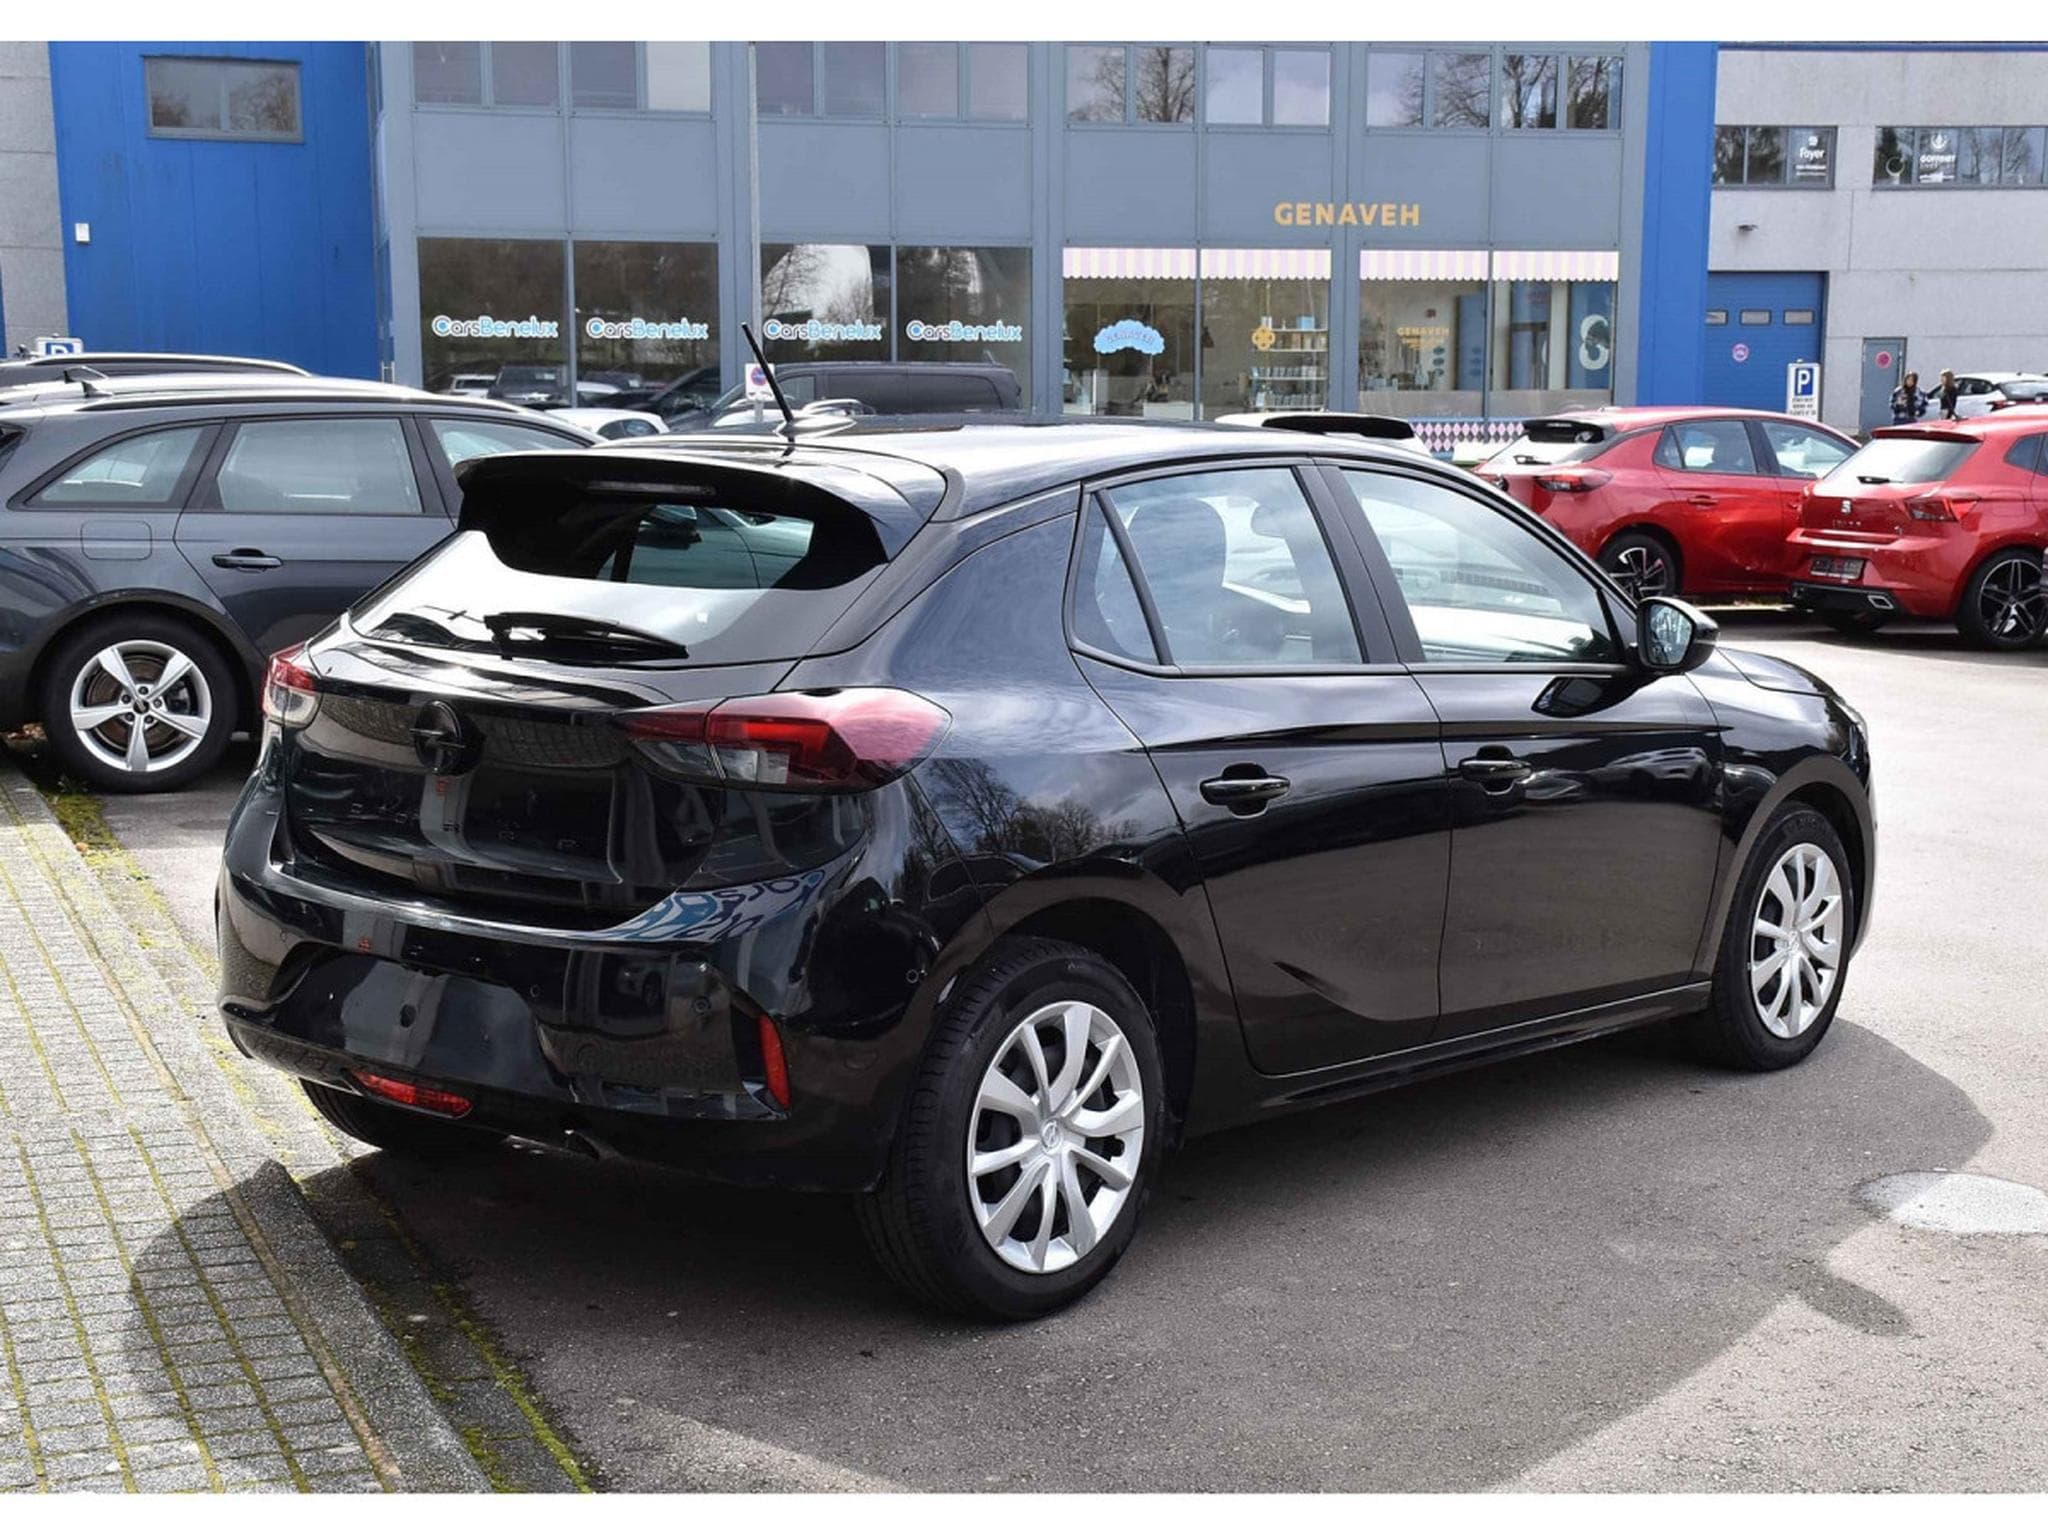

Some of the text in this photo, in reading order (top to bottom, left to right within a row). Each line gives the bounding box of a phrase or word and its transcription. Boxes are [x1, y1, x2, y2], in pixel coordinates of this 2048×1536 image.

[1274, 202, 1420, 226] GENAVEH
[432, 315, 559, 338] CarsBenelux
[586, 317, 709, 339] CarsBenelux
[763, 319, 882, 341] CarsBenelux
[906, 320, 1022, 342] CarsBenelux
[1797, 370, 1811, 394] P
